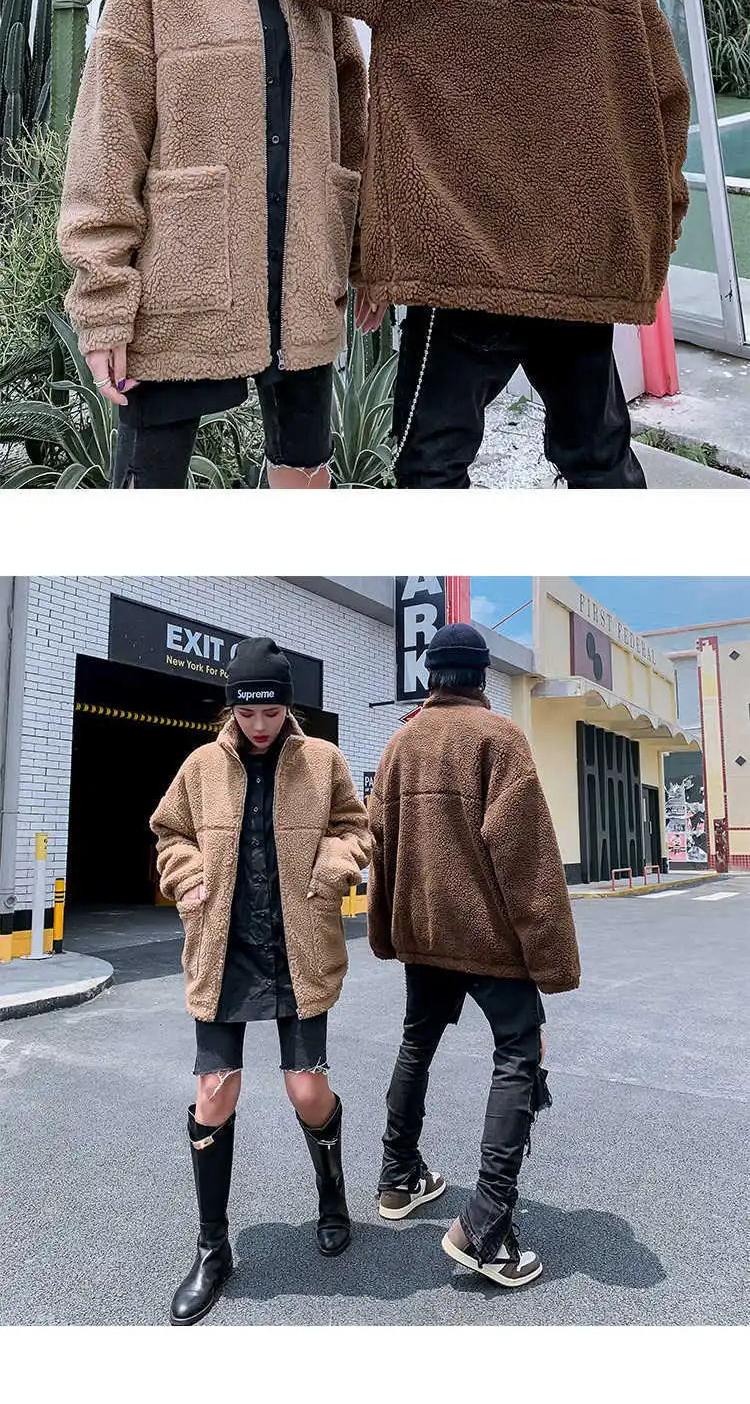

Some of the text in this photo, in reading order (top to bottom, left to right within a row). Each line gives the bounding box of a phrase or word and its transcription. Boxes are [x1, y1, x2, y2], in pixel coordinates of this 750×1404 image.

[166, 623, 224, 662] EXIT
[579, 593, 657, 666] FIRST FEDERAL
[166, 655, 185, 667] New
[186, 660, 204, 672] York
[206, 665, 219, 676] For
[237, 689, 275, 701] Supreme
